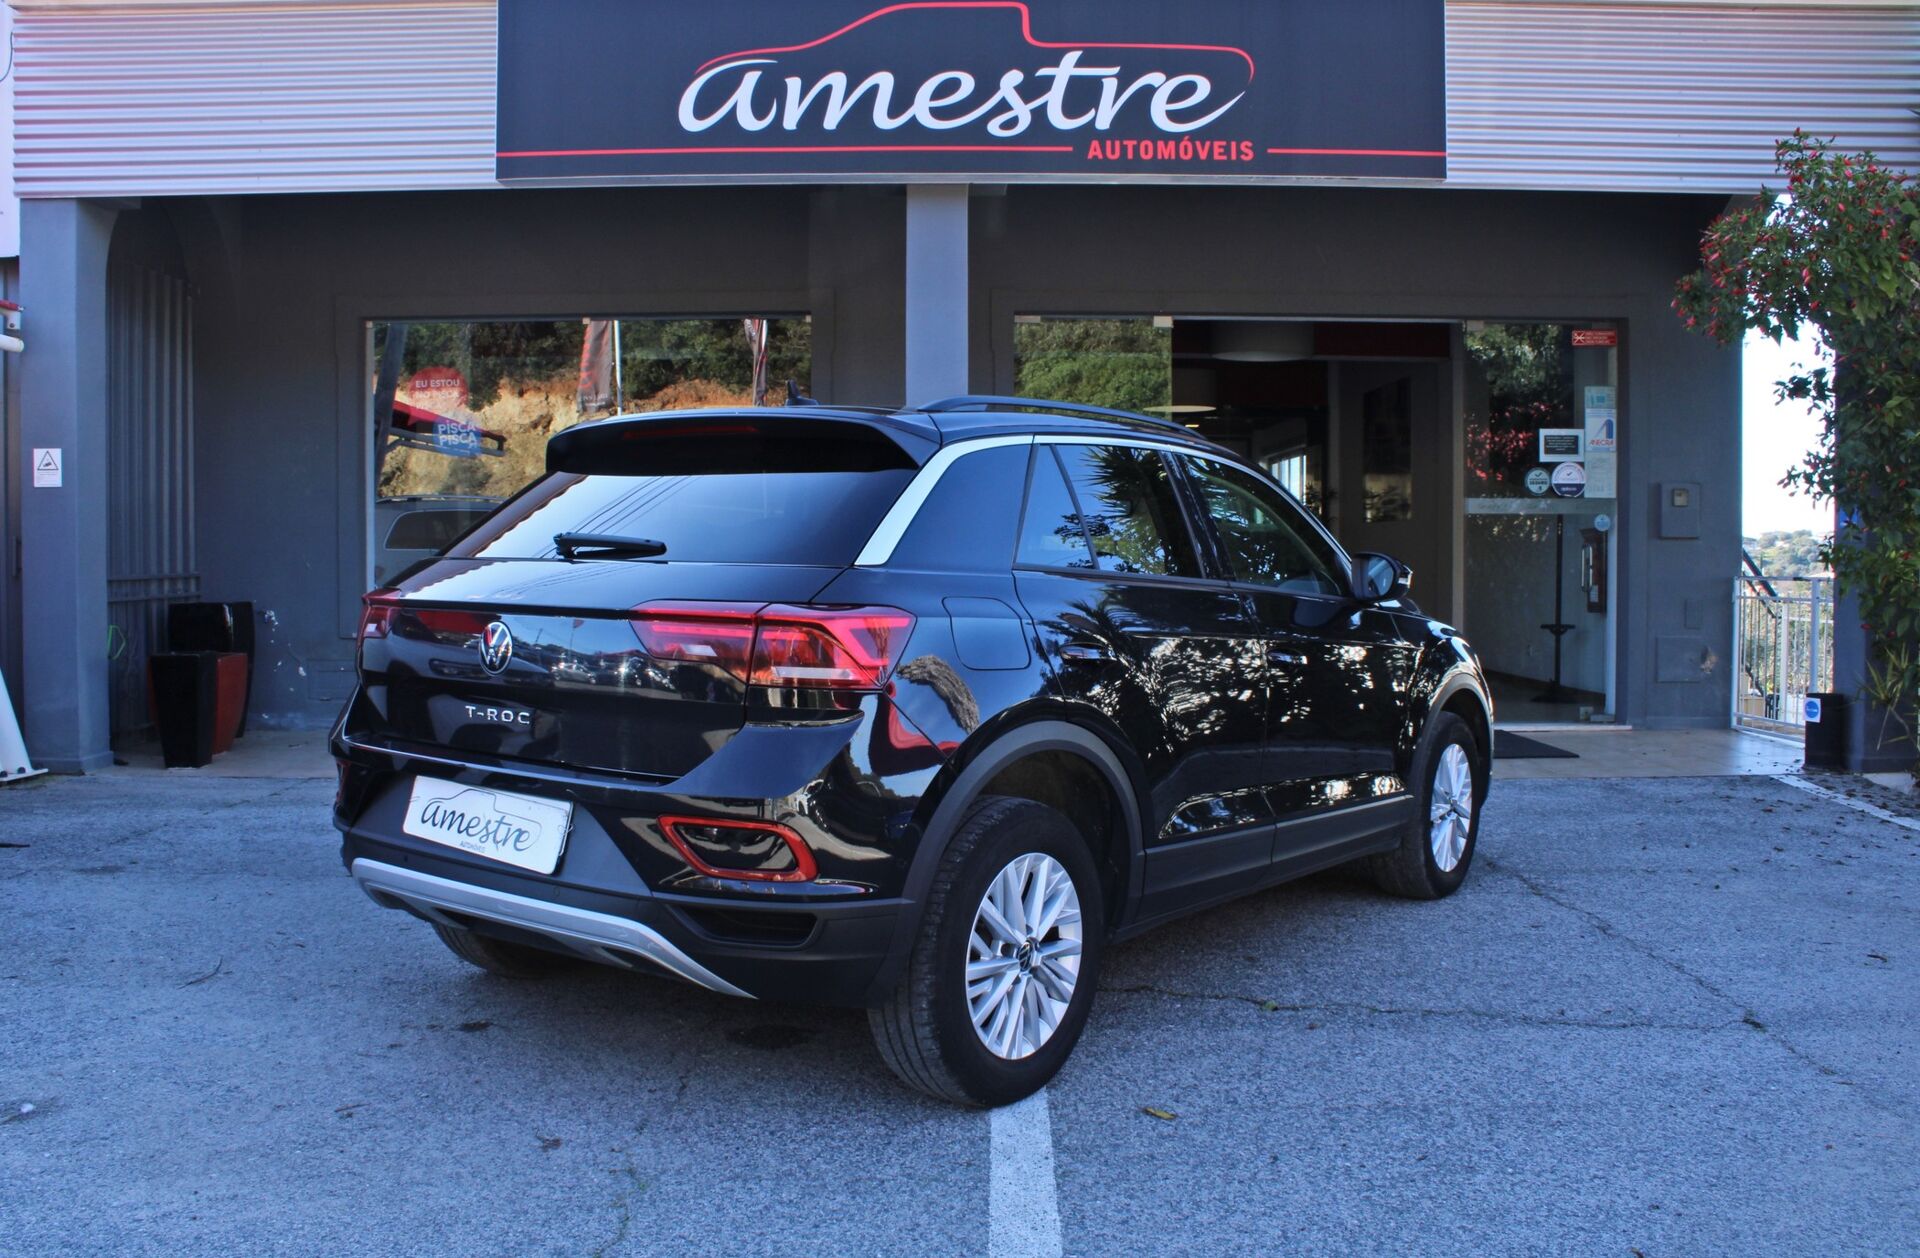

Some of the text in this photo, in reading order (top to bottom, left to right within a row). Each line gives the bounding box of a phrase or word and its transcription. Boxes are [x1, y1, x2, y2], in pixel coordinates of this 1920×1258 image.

[678, 50, 1246, 137] amestre
[1087, 136, 1255, 161] AUTOMÓVEIS
[415, 379, 460, 388] EU ESTOU
[464, 705, 531, 725] T-ROC
[420, 801, 532, 852] amestre
